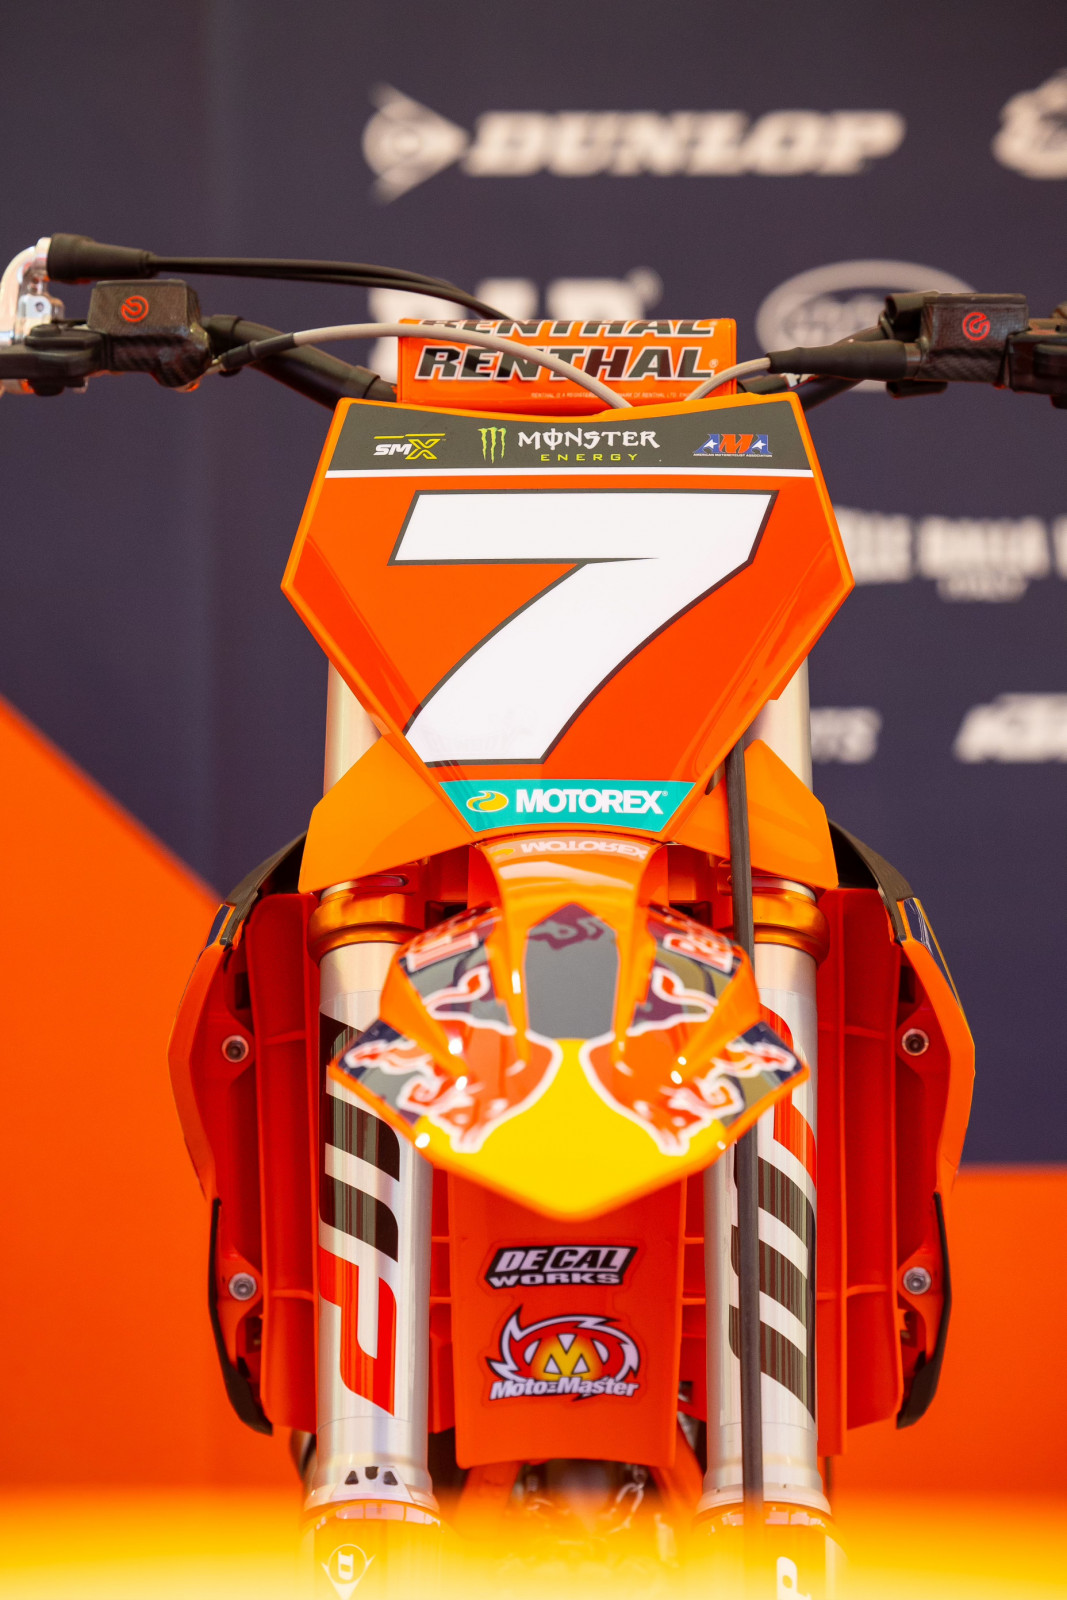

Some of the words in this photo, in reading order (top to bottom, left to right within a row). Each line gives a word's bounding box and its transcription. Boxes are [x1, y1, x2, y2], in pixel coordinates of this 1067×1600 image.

[463, 110, 905, 177] DUNLOP
[373, 438, 441, 460] SMX
[518, 428, 661, 450] MONSTER
[692, 433, 773, 454] AMA
[540, 453, 638, 462] ENERGY
[387, 489, 779, 768] 7
[494, 1246, 633, 1273] DECAL
[488, 1273, 621, 1288] WORKS
